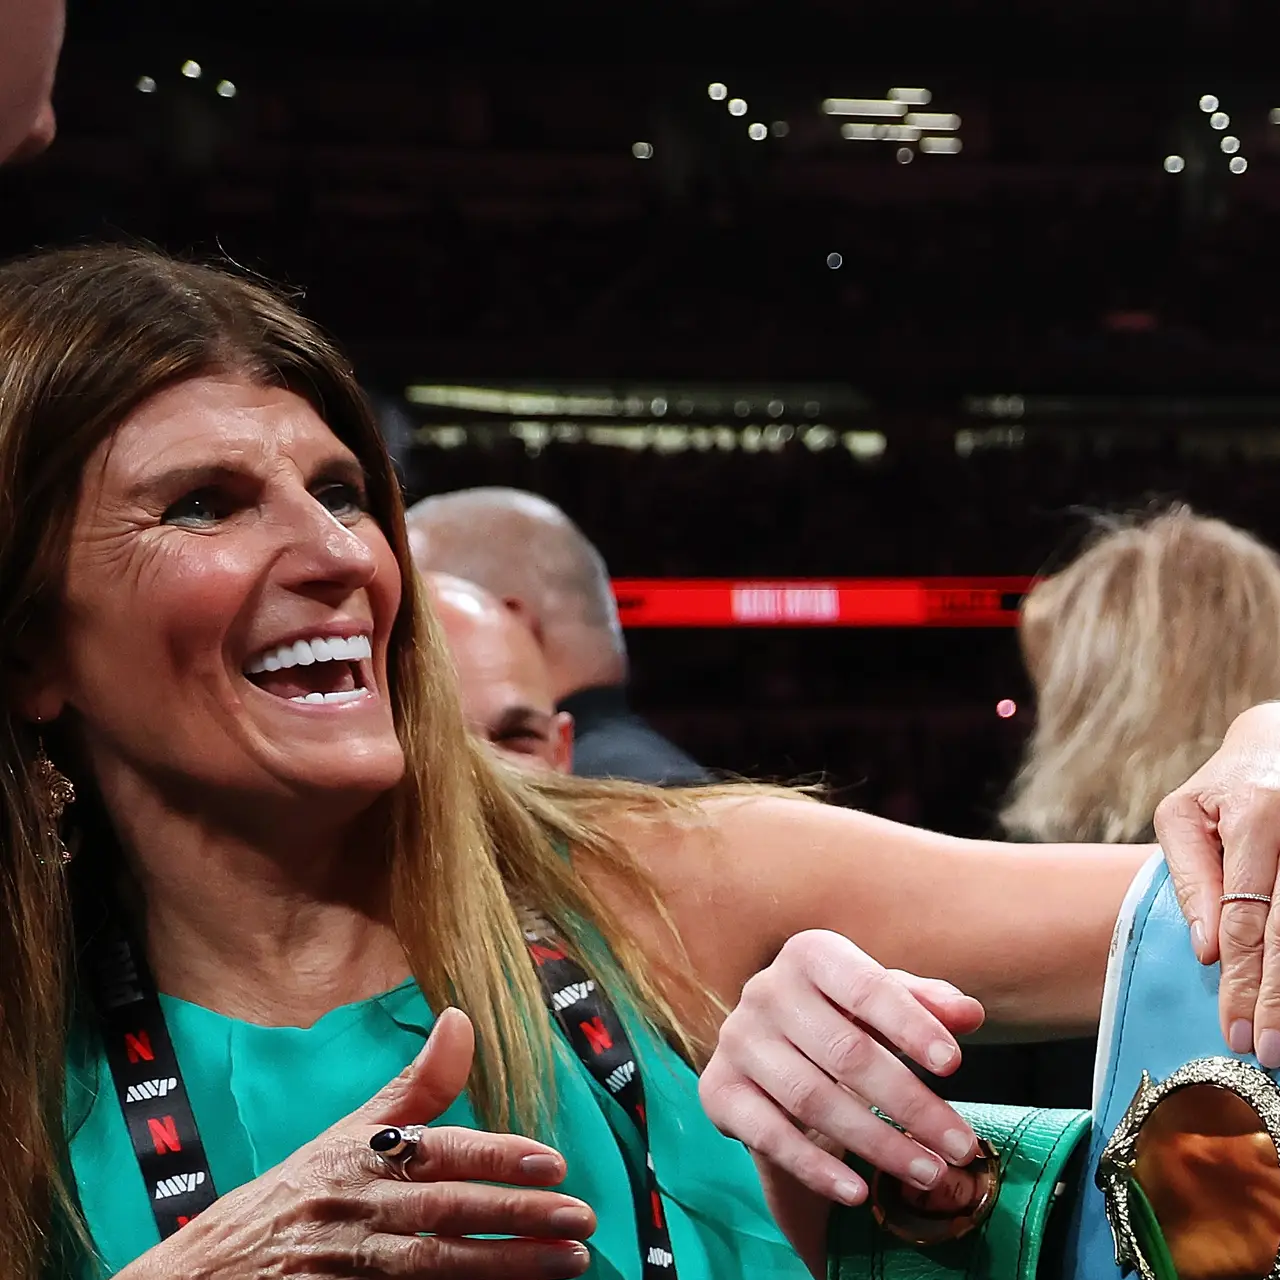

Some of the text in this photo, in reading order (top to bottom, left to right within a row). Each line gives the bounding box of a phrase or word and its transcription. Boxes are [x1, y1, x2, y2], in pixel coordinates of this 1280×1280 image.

[123, 1029, 156, 1066] N
[580, 1016, 613, 1056] N
[125, 1077, 178, 1104] MVP
[147, 1115, 182, 1156] N
[155, 1171, 207, 1201] MVP
